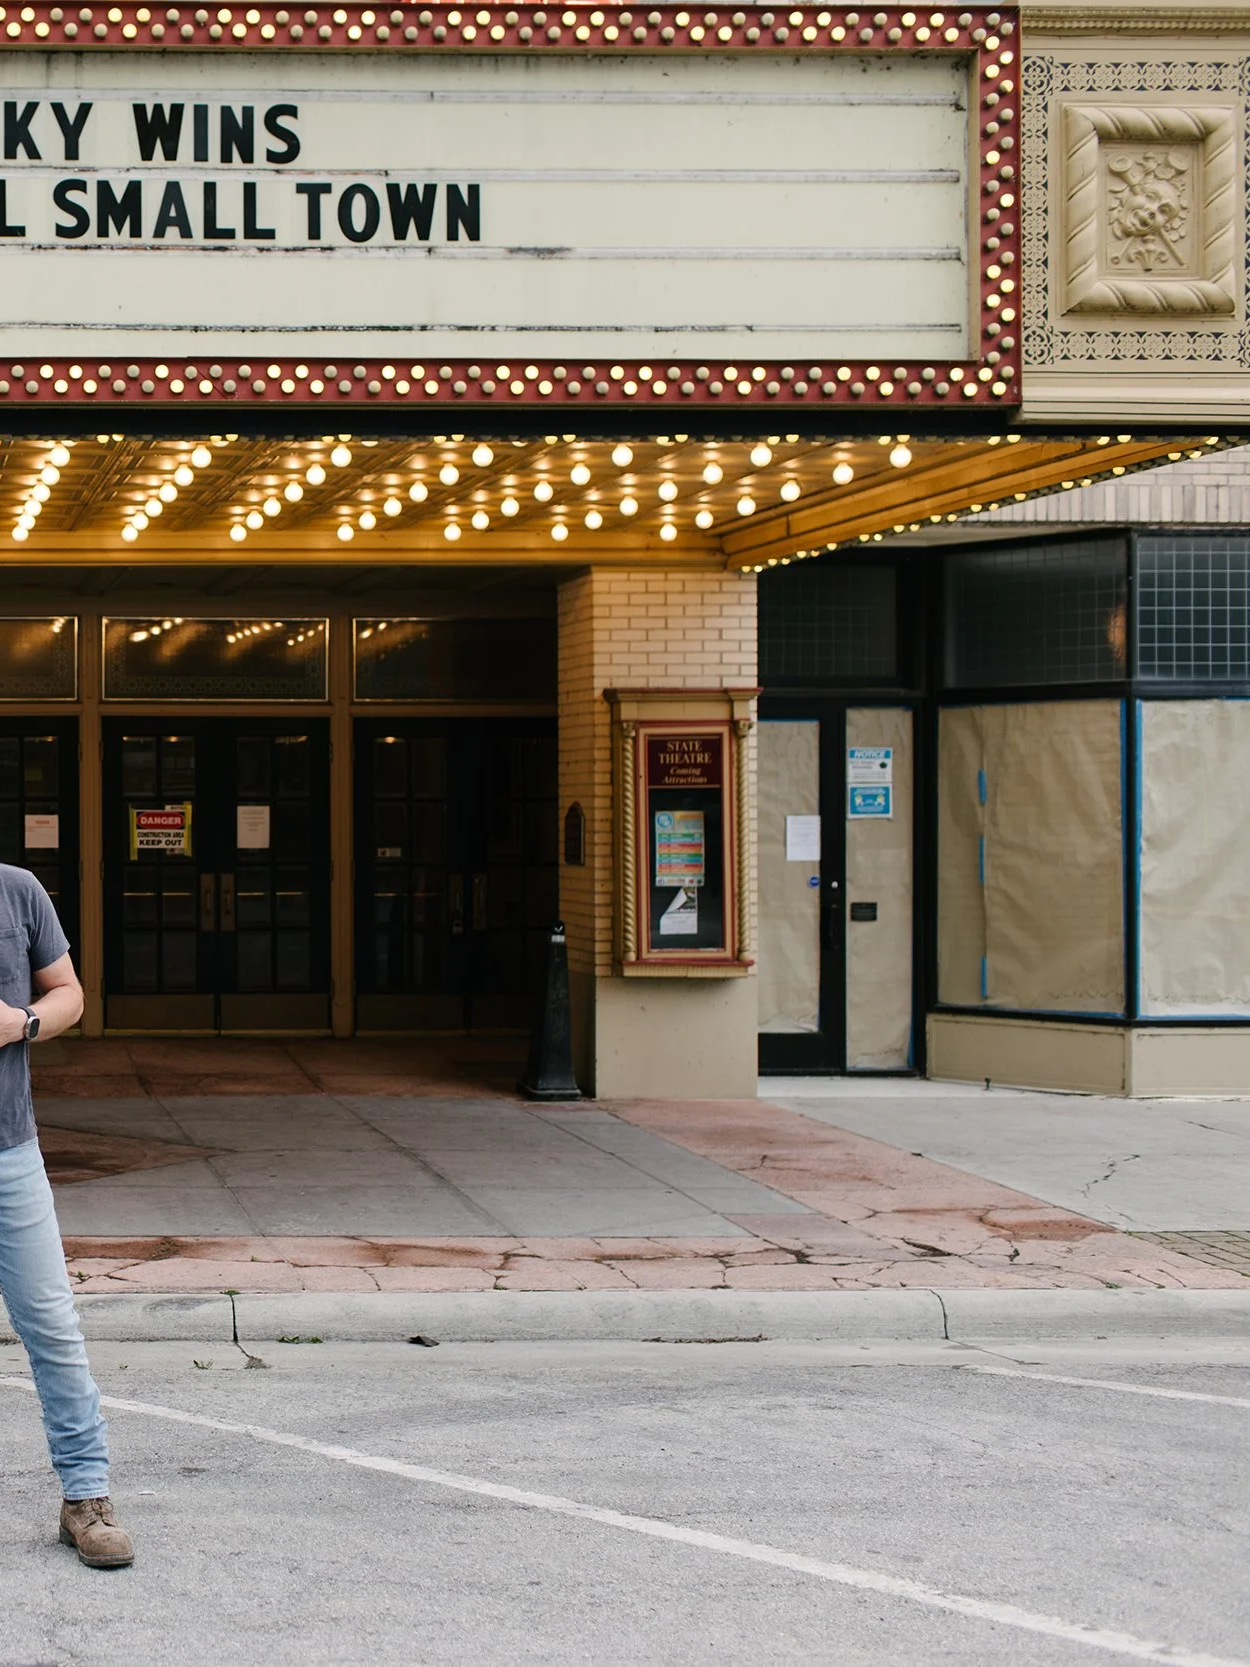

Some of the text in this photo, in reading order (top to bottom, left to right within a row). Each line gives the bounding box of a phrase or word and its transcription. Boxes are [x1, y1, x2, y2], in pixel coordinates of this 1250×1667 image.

[132, 102, 301, 165] WINS
[52, 178, 276, 240] SMALL
[296, 182, 481, 242] TOWN
[667, 740, 702, 752] STATE
[658, 753, 712, 764] THEATRE
[854, 749, 886, 758] NOTICE
[670, 766, 702, 776] Coming
[662, 775, 708, 784] Attractions
[140, 816, 182, 825] DANGER
